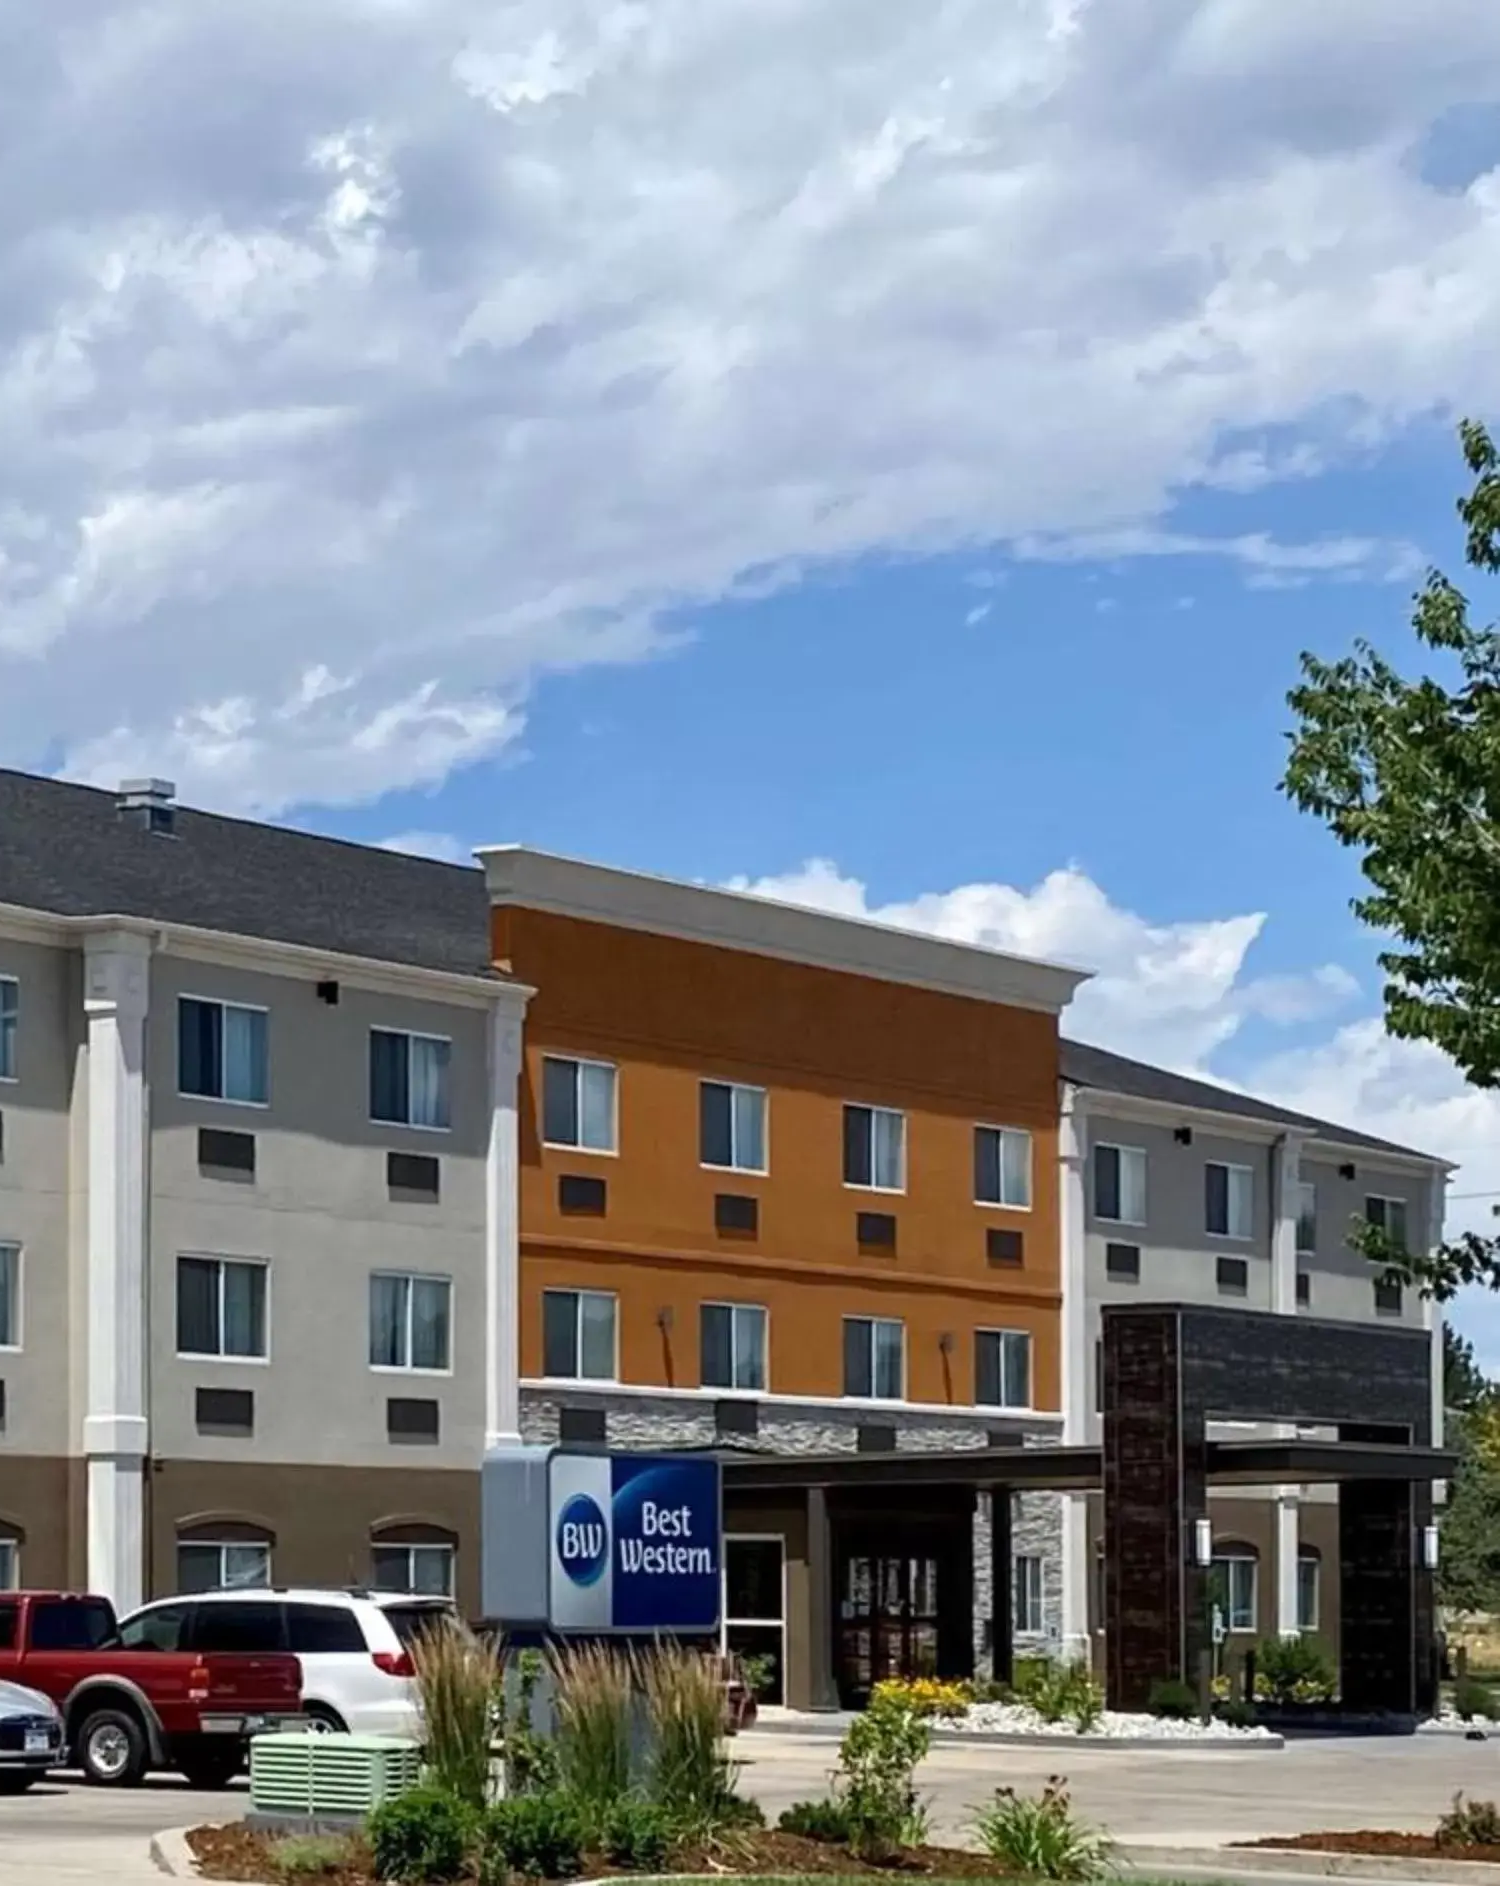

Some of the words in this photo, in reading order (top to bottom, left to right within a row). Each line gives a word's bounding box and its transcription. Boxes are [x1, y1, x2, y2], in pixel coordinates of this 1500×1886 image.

[642, 1501, 692, 1537] Best
[563, 1522, 602, 1558] BW
[620, 1538, 711, 1574] Western
